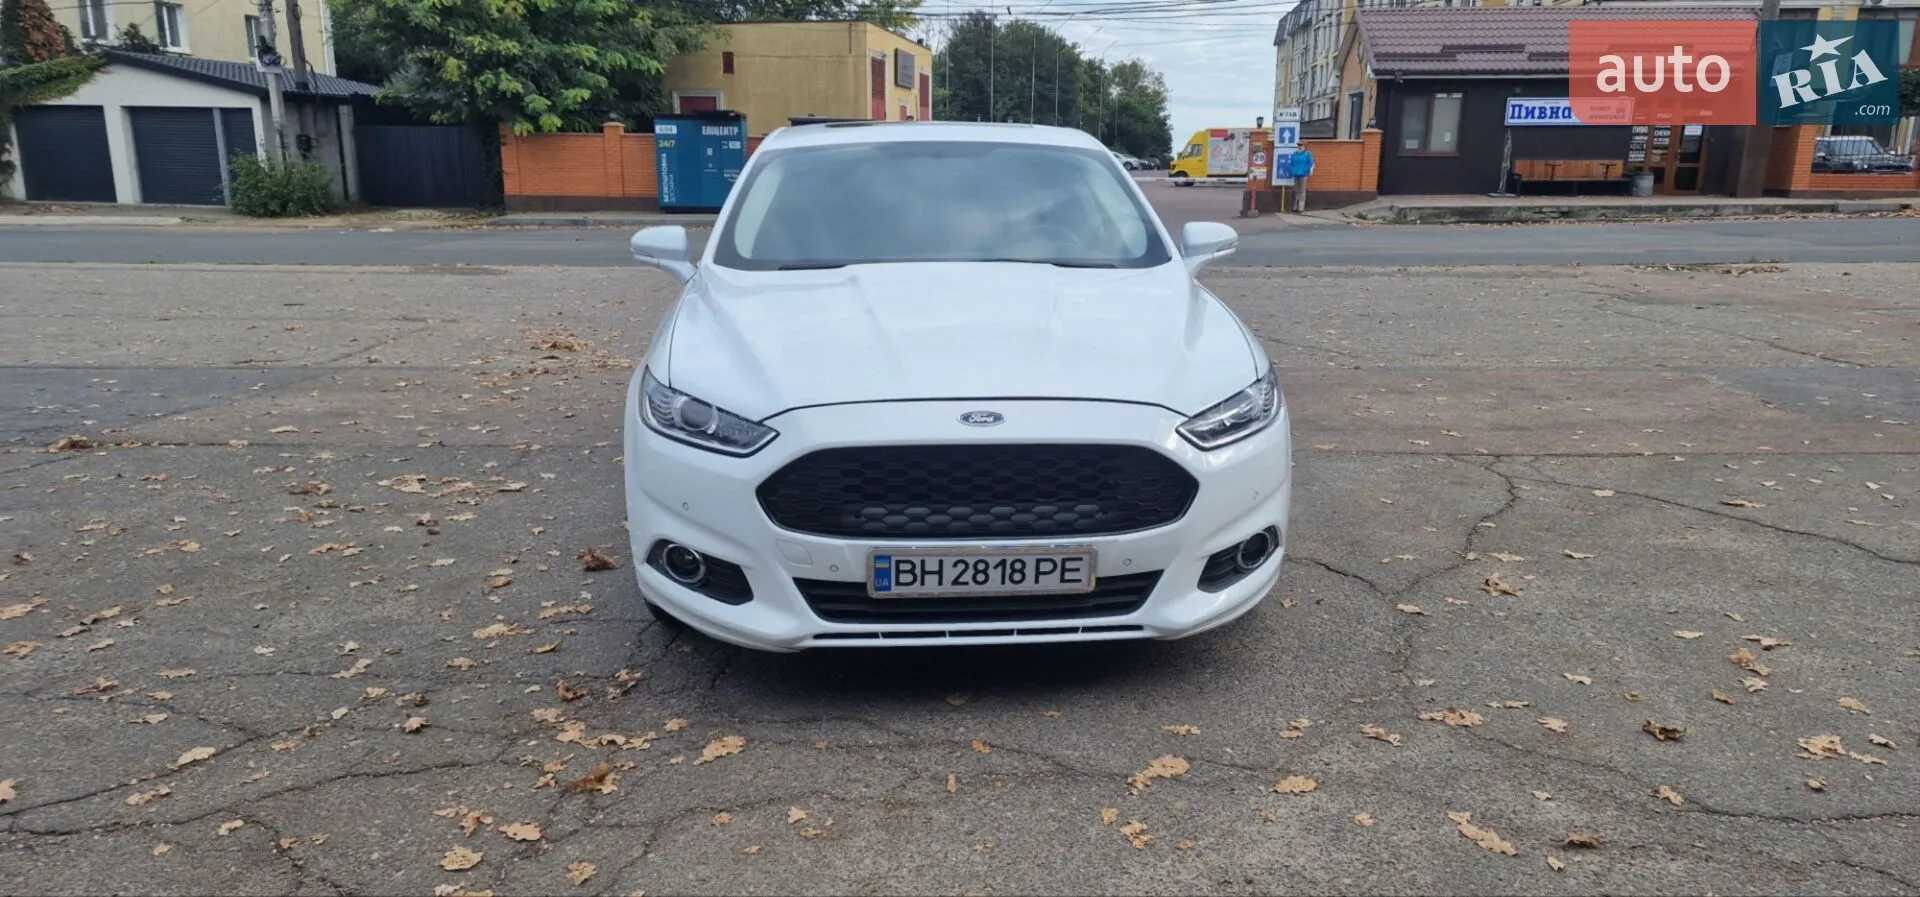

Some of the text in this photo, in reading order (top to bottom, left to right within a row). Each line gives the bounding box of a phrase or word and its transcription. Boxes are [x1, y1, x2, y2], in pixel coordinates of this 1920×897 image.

[1509, 103, 1572, 120] Пивна
[658, 139, 675, 148] 24/7
[1254, 154, 1265, 162] 20
[894, 556, 1084, 587] BH 2818 PE
[875, 578, 890, 588] UA
